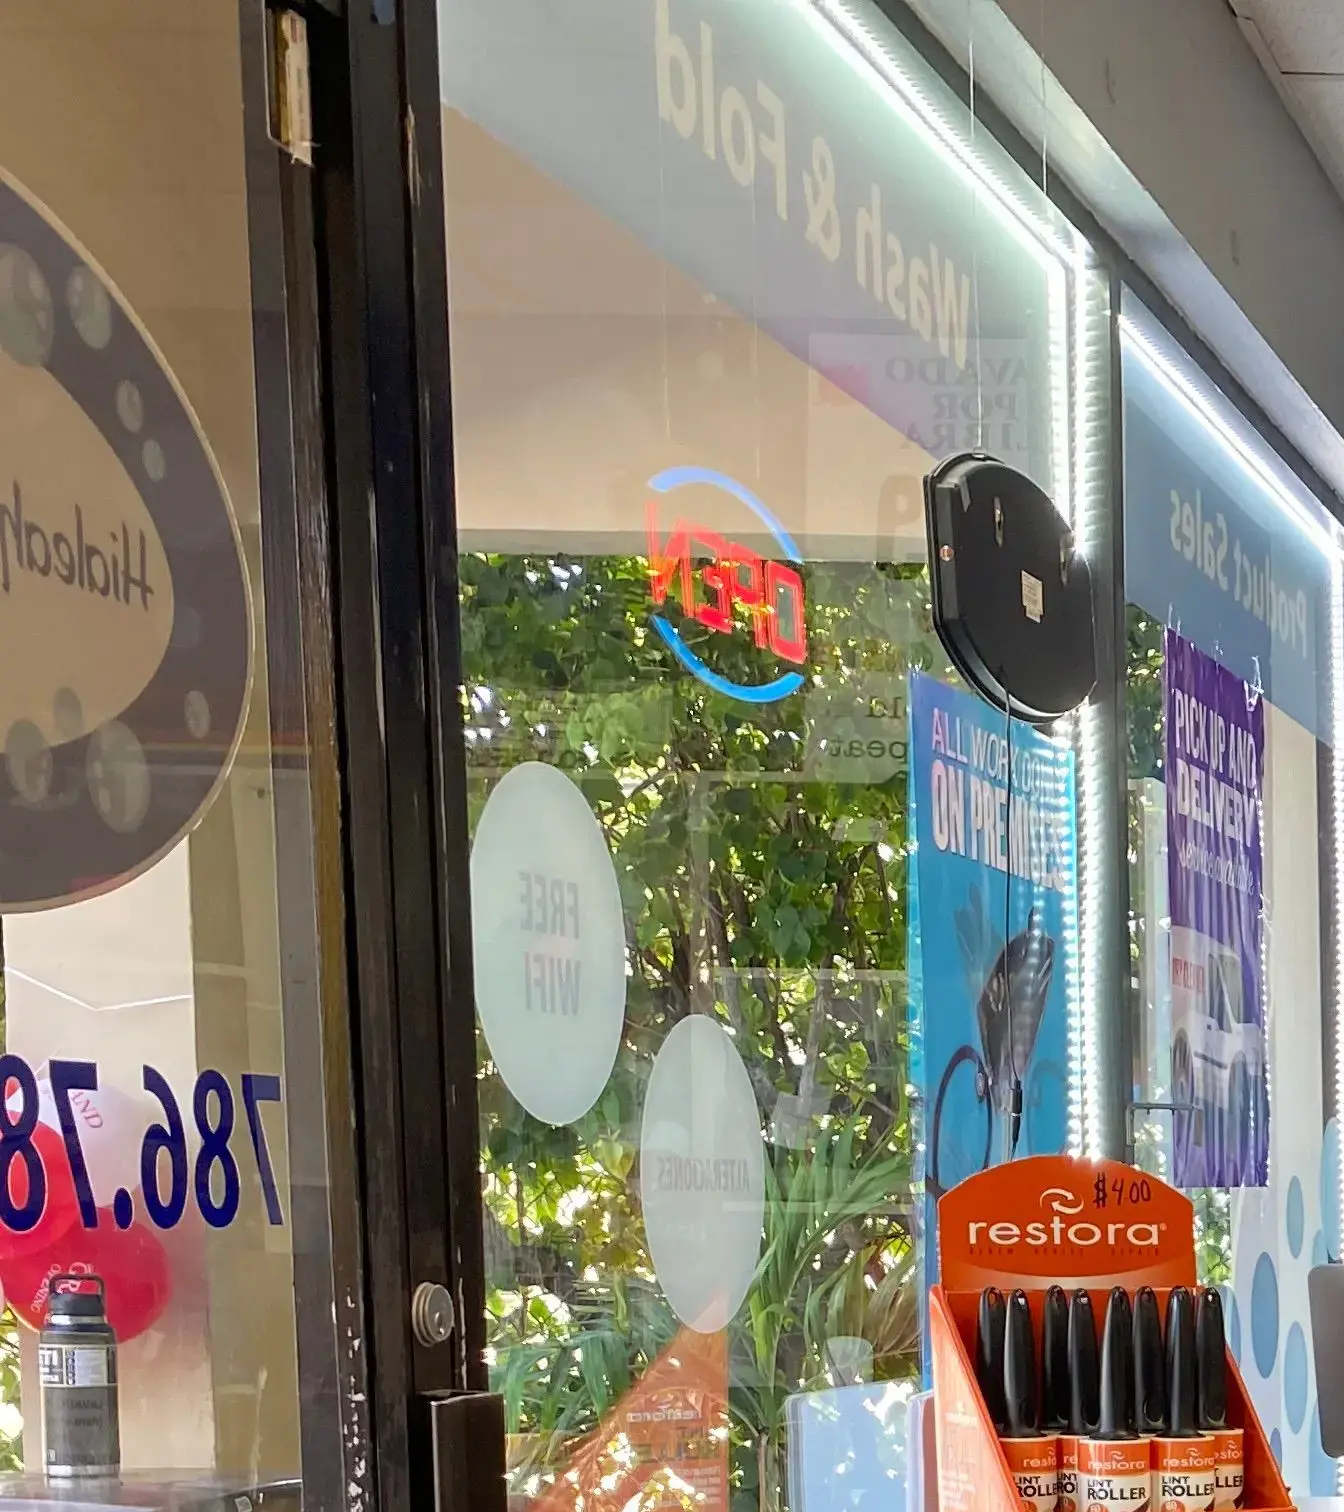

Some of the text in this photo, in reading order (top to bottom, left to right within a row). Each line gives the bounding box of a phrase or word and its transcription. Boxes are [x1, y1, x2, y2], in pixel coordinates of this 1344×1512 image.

[932, 708, 1017, 787] ALL WORK
[1175, 687, 1256, 788] PICK UP AND
[932, 760, 1066, 894] ON PREMISES
[1176, 758, 1255, 847] DELIVERY
[968, 1215, 1160, 1246] restora
[1087, 1488, 1146, 1500] ROLLER
[1088, 1480, 1112, 1488] LINT
[1162, 1476, 1190, 1485] LINT
